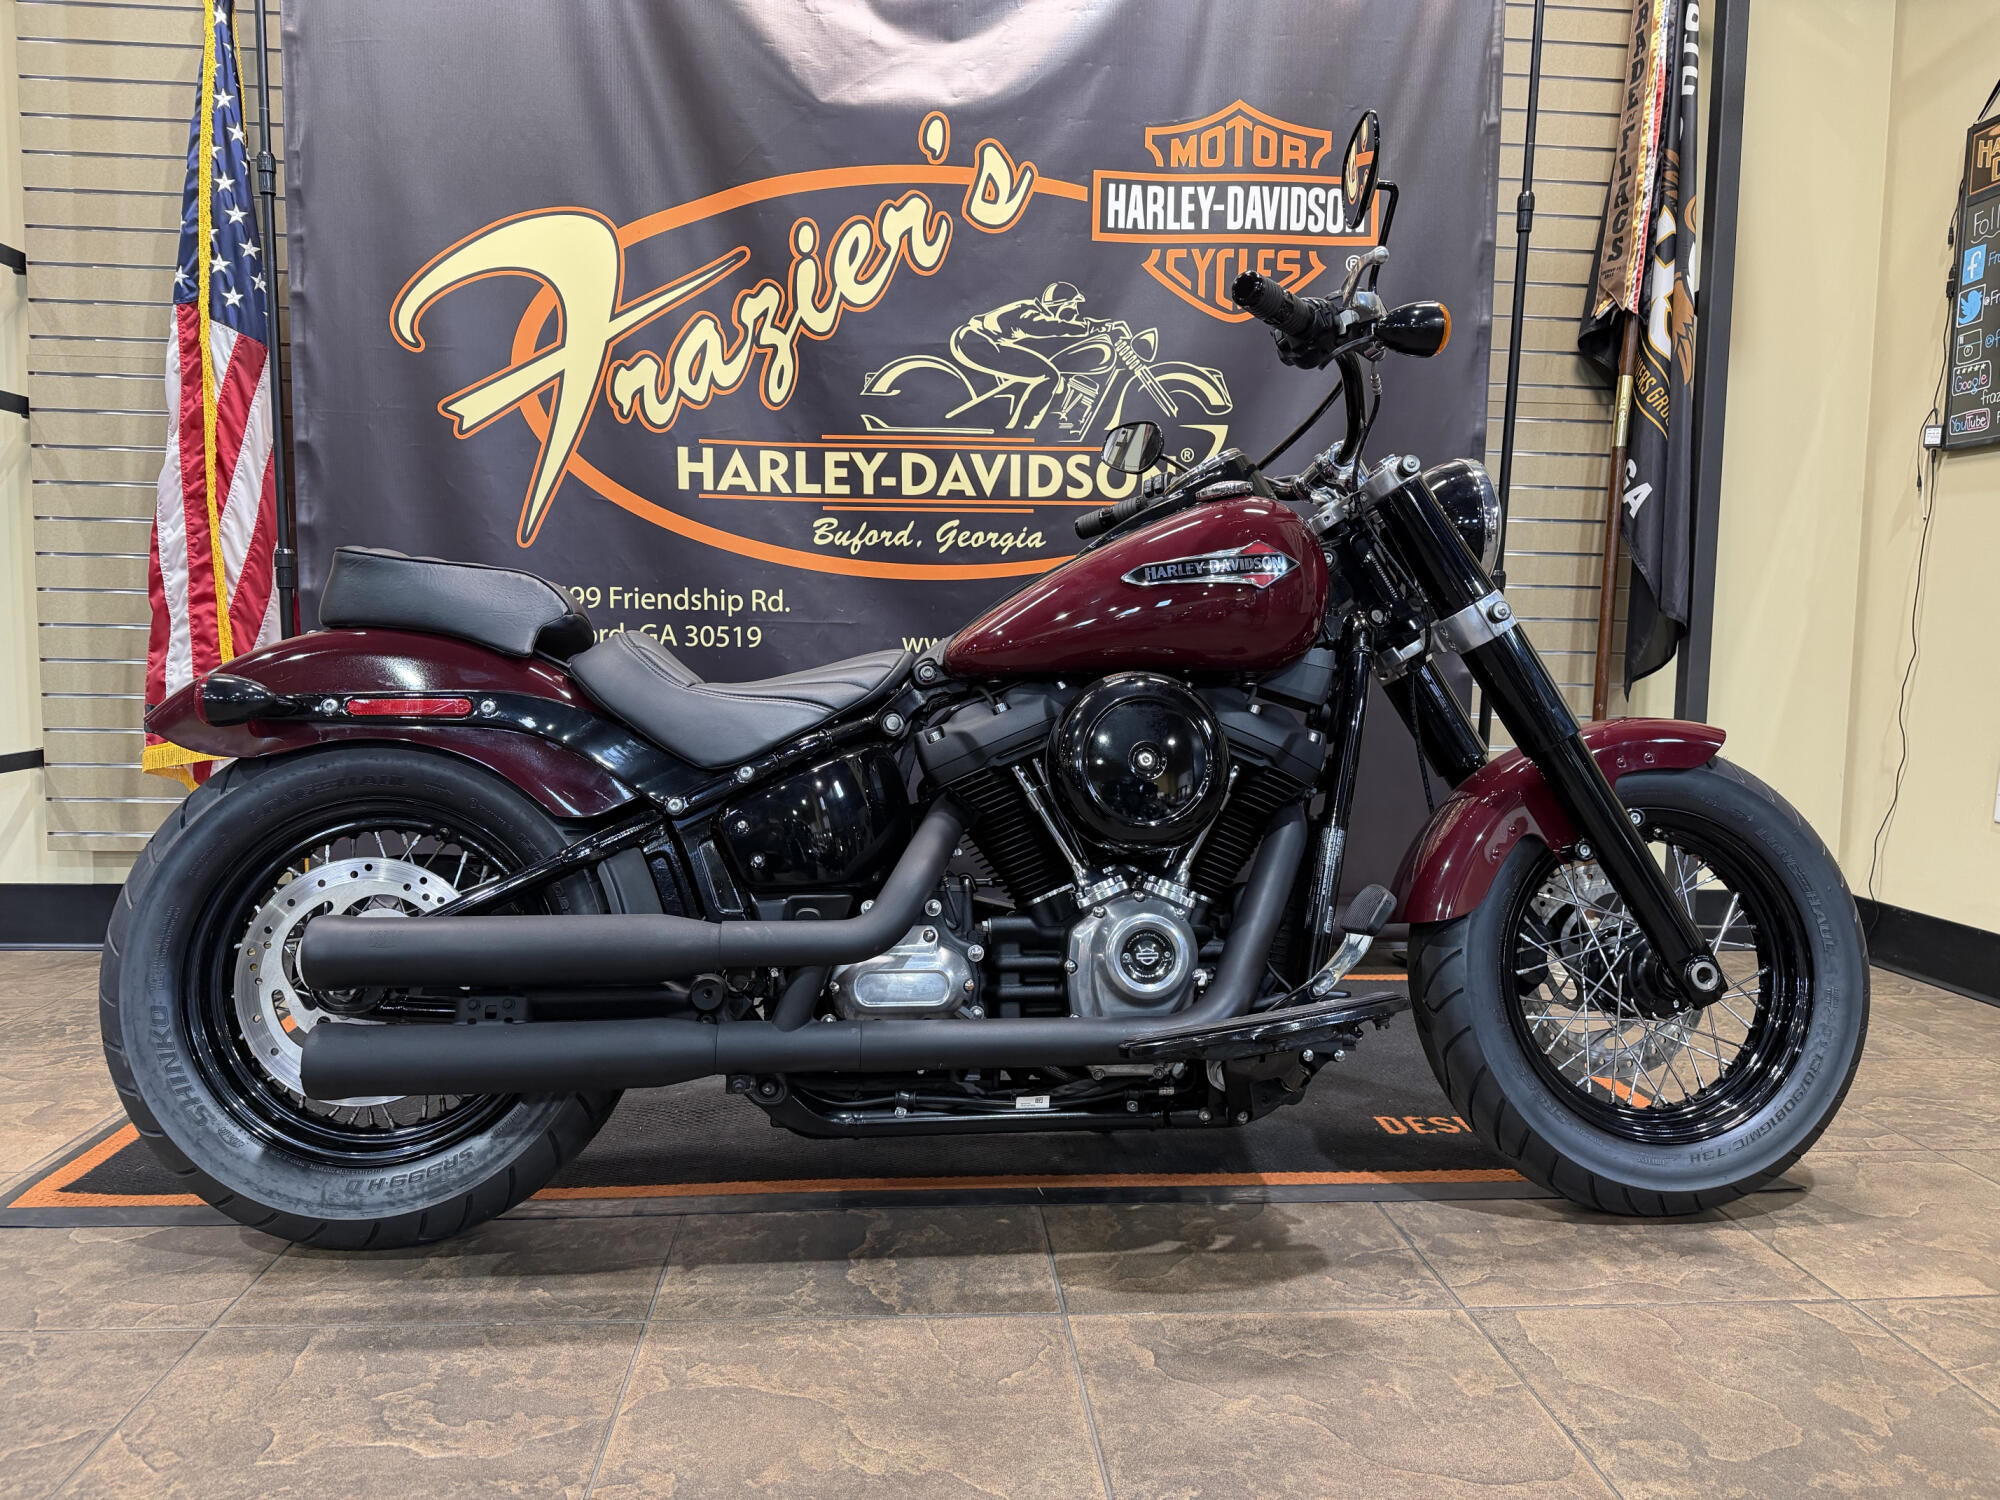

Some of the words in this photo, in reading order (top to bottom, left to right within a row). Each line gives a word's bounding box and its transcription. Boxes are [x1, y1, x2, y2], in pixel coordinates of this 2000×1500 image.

[1627, 0, 1648, 110] RADE
[1172, 116, 1307, 169] MOTOR
[1108, 184, 1364, 234] HARLEY-DAVIDSO
[1607, 123, 1635, 262] FLAGS
[389, 110, 1038, 549] Frazier's
[1955, 367, 1988, 395] Google
[1951, 415, 1987, 432] YouTube
[812, 517, 921, 555] Buford,
[935, 518, 1047, 554] Georgia
[1144, 555, 1284, 581] HARLEY-DAVIDSON
[563, 586, 602, 609] 99
[609, 586, 744, 617] Friendship
[751, 589, 790, 613] Rd.
[685, 625, 762, 649] 30519
[150, 1005, 218, 1127] SHINKO
